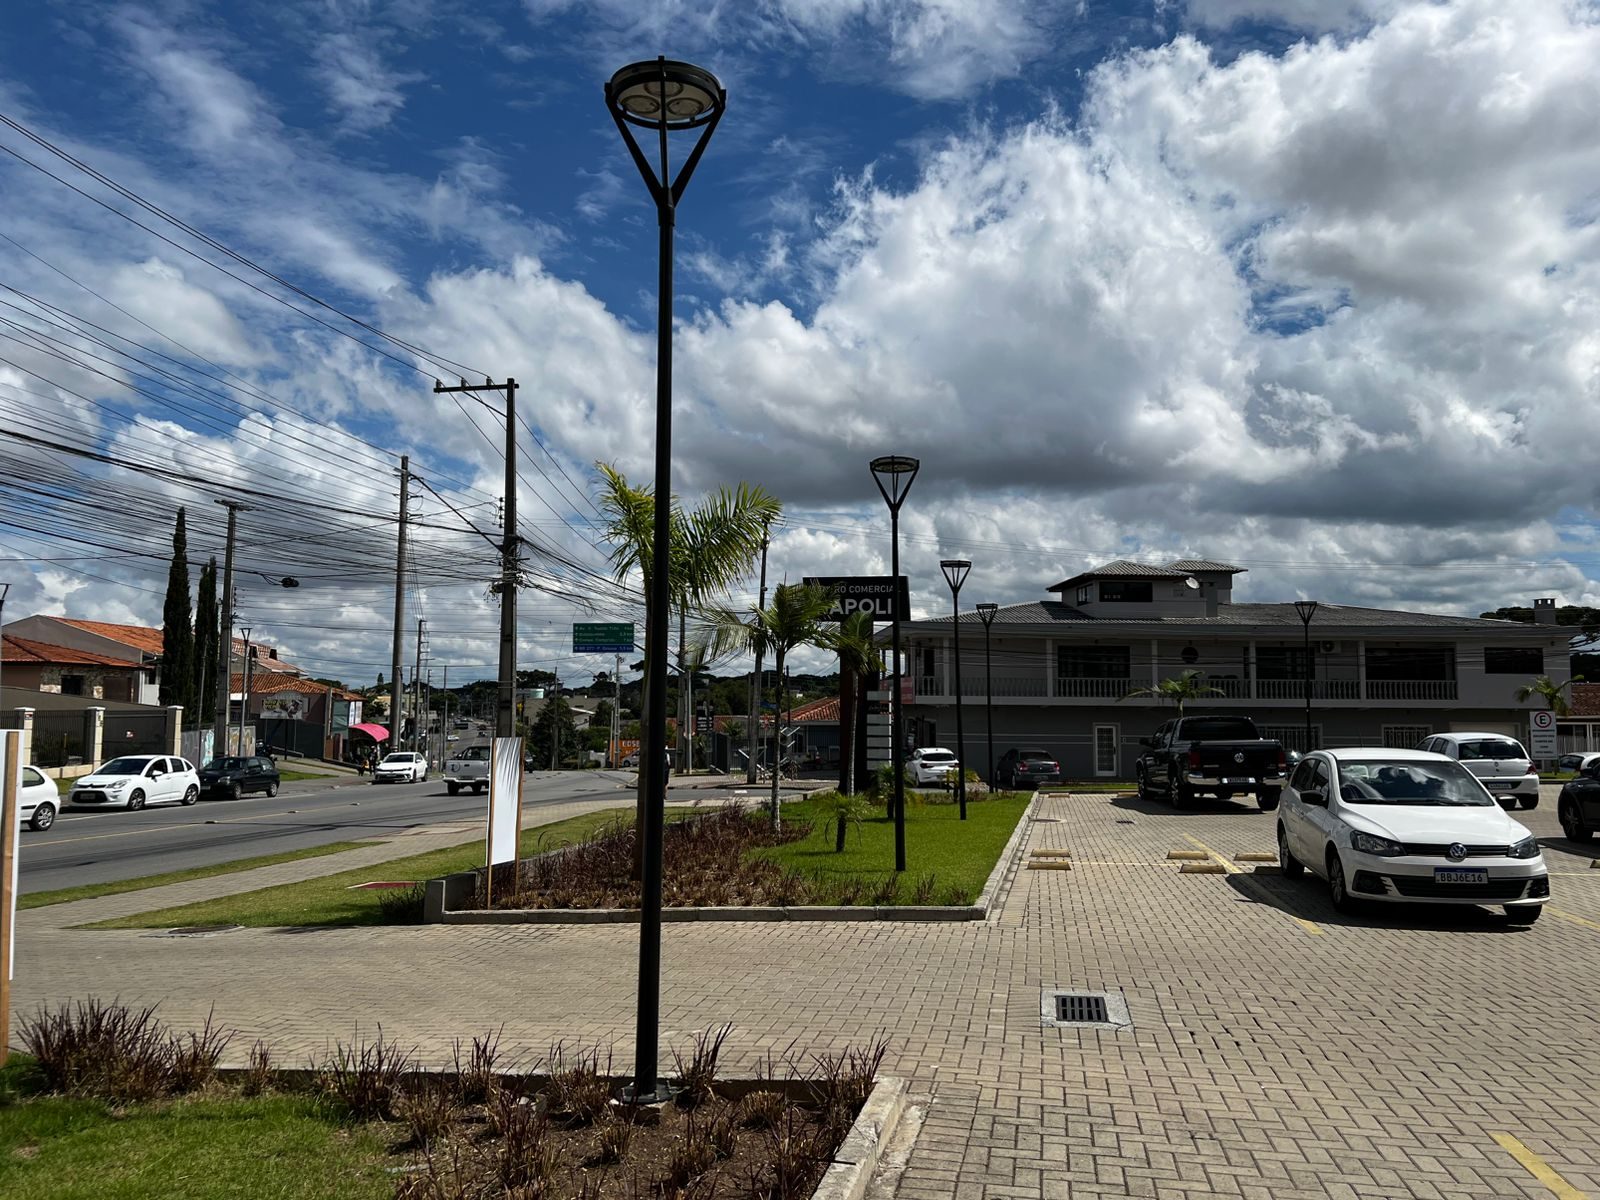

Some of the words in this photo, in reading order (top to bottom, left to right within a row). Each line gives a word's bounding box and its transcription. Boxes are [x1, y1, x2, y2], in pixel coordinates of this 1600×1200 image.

[849, 585, 901, 593] COMERCIA
[815, 598, 892, 615] APOLI
[1540, 715, 1546, 724] E
